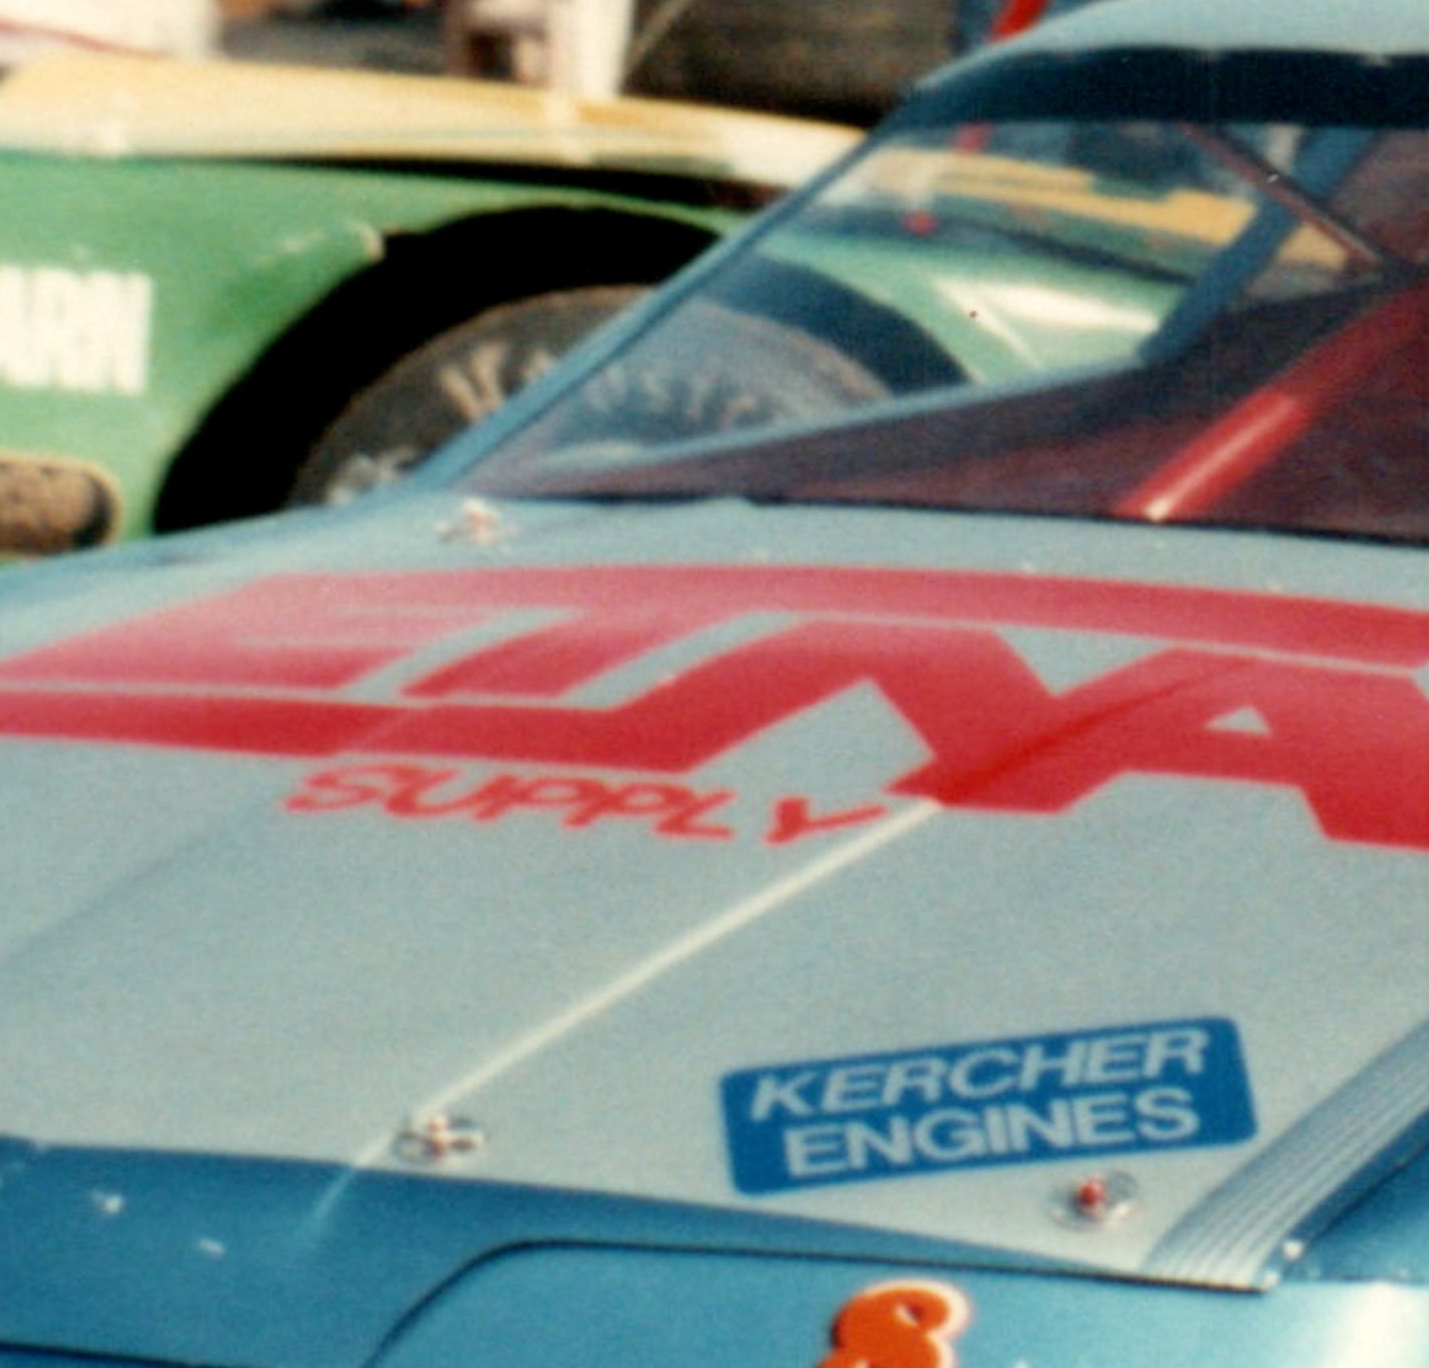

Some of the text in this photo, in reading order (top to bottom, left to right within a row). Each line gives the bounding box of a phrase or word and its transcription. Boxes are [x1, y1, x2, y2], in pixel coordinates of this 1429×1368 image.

[283, 763, 889, 845] SUPPLY
[750, 1027, 1210, 1121] KERCHER
[782, 1086, 1201, 1180] ENGINES
